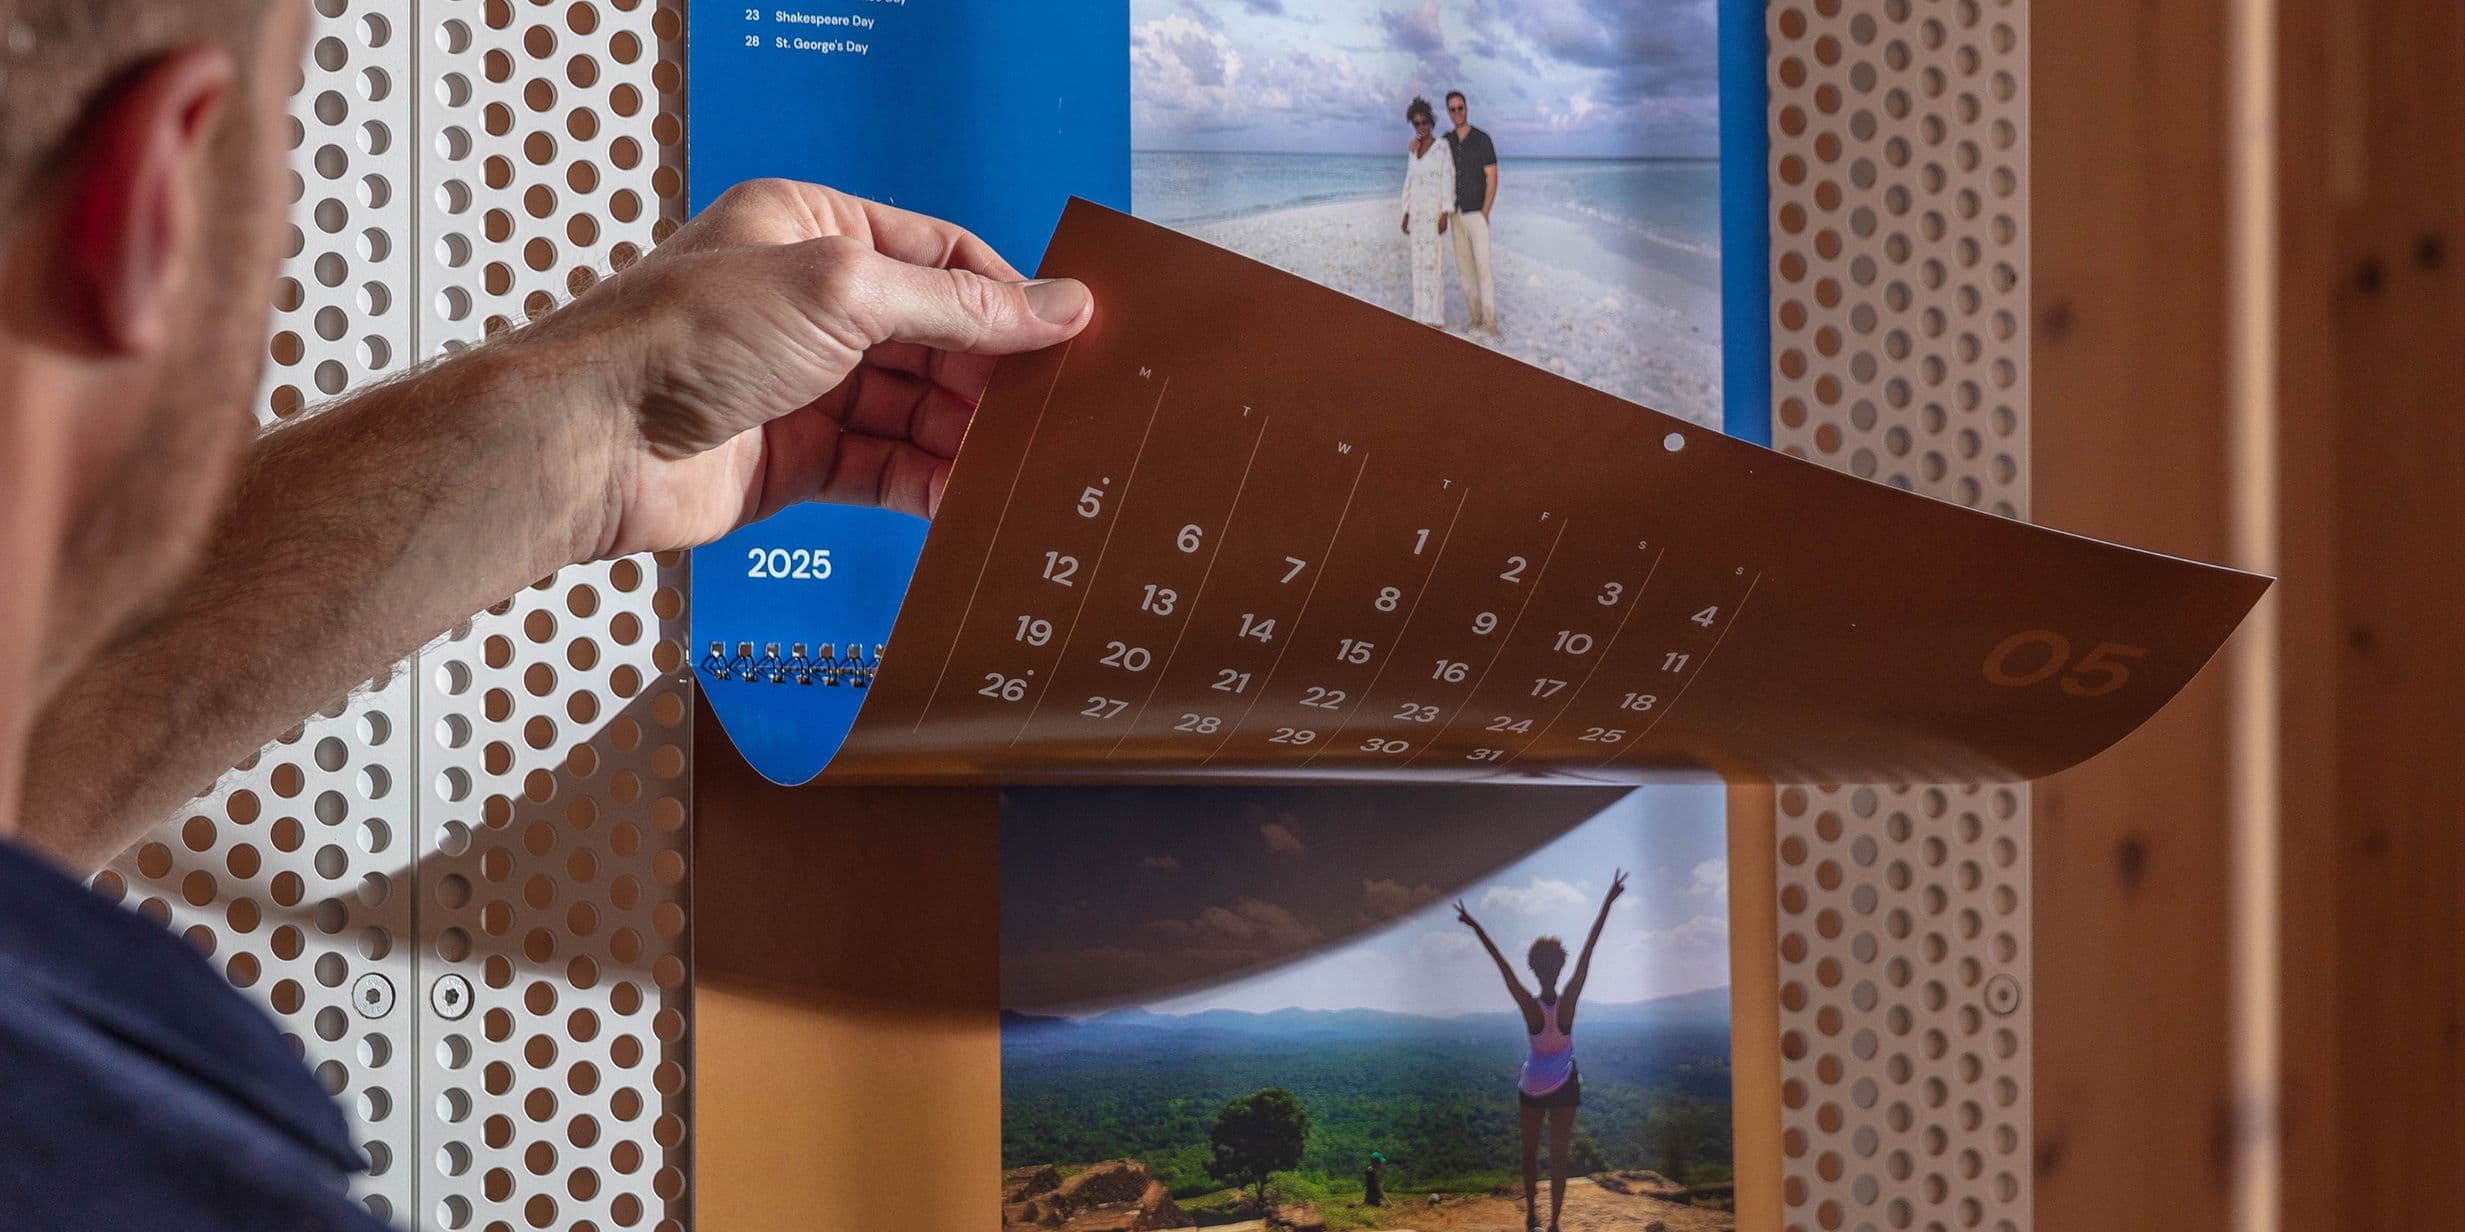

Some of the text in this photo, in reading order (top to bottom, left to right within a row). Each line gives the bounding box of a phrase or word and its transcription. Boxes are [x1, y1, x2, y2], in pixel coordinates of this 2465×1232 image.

[745, 9, 874, 30] 23 Shakespeare Day
[745, 35, 869, 56] 28 St. George's Day
[1139, 366, 1745, 576] M T W T F S S
[748, 547, 832, 580] 2025
[1077, 486, 1690, 673] 5 6 7 8 9 10 11
[1413, 528, 1718, 628] 1 2 3 4
[1042, 551, 1657, 711] 12 13 14 15 16 17 18
[1981, 629, 2146, 697] 05
[978, 672, 1505, 761] 26 27 28 29 30 31
[1015, 615, 1627, 743] 19 20 21 22 23 24 25
